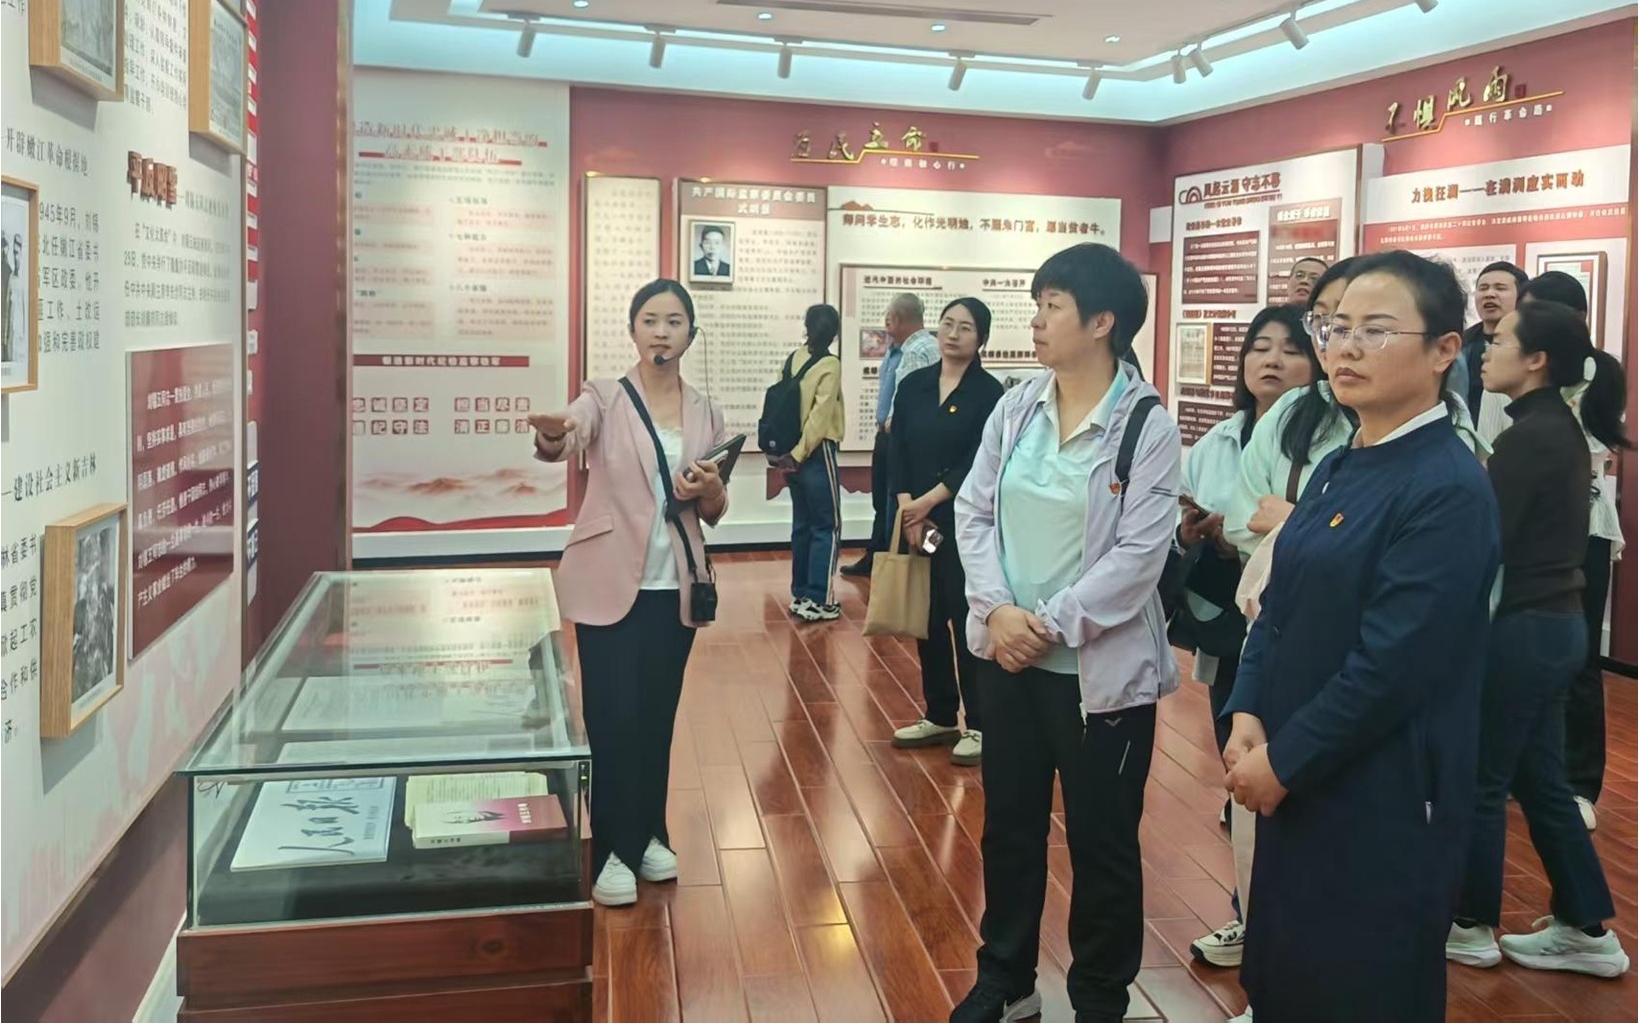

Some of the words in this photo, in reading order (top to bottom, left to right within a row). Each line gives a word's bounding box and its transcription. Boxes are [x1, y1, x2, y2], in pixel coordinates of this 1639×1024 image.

[14, 452, 96, 502] 建设社会主义新吉林
